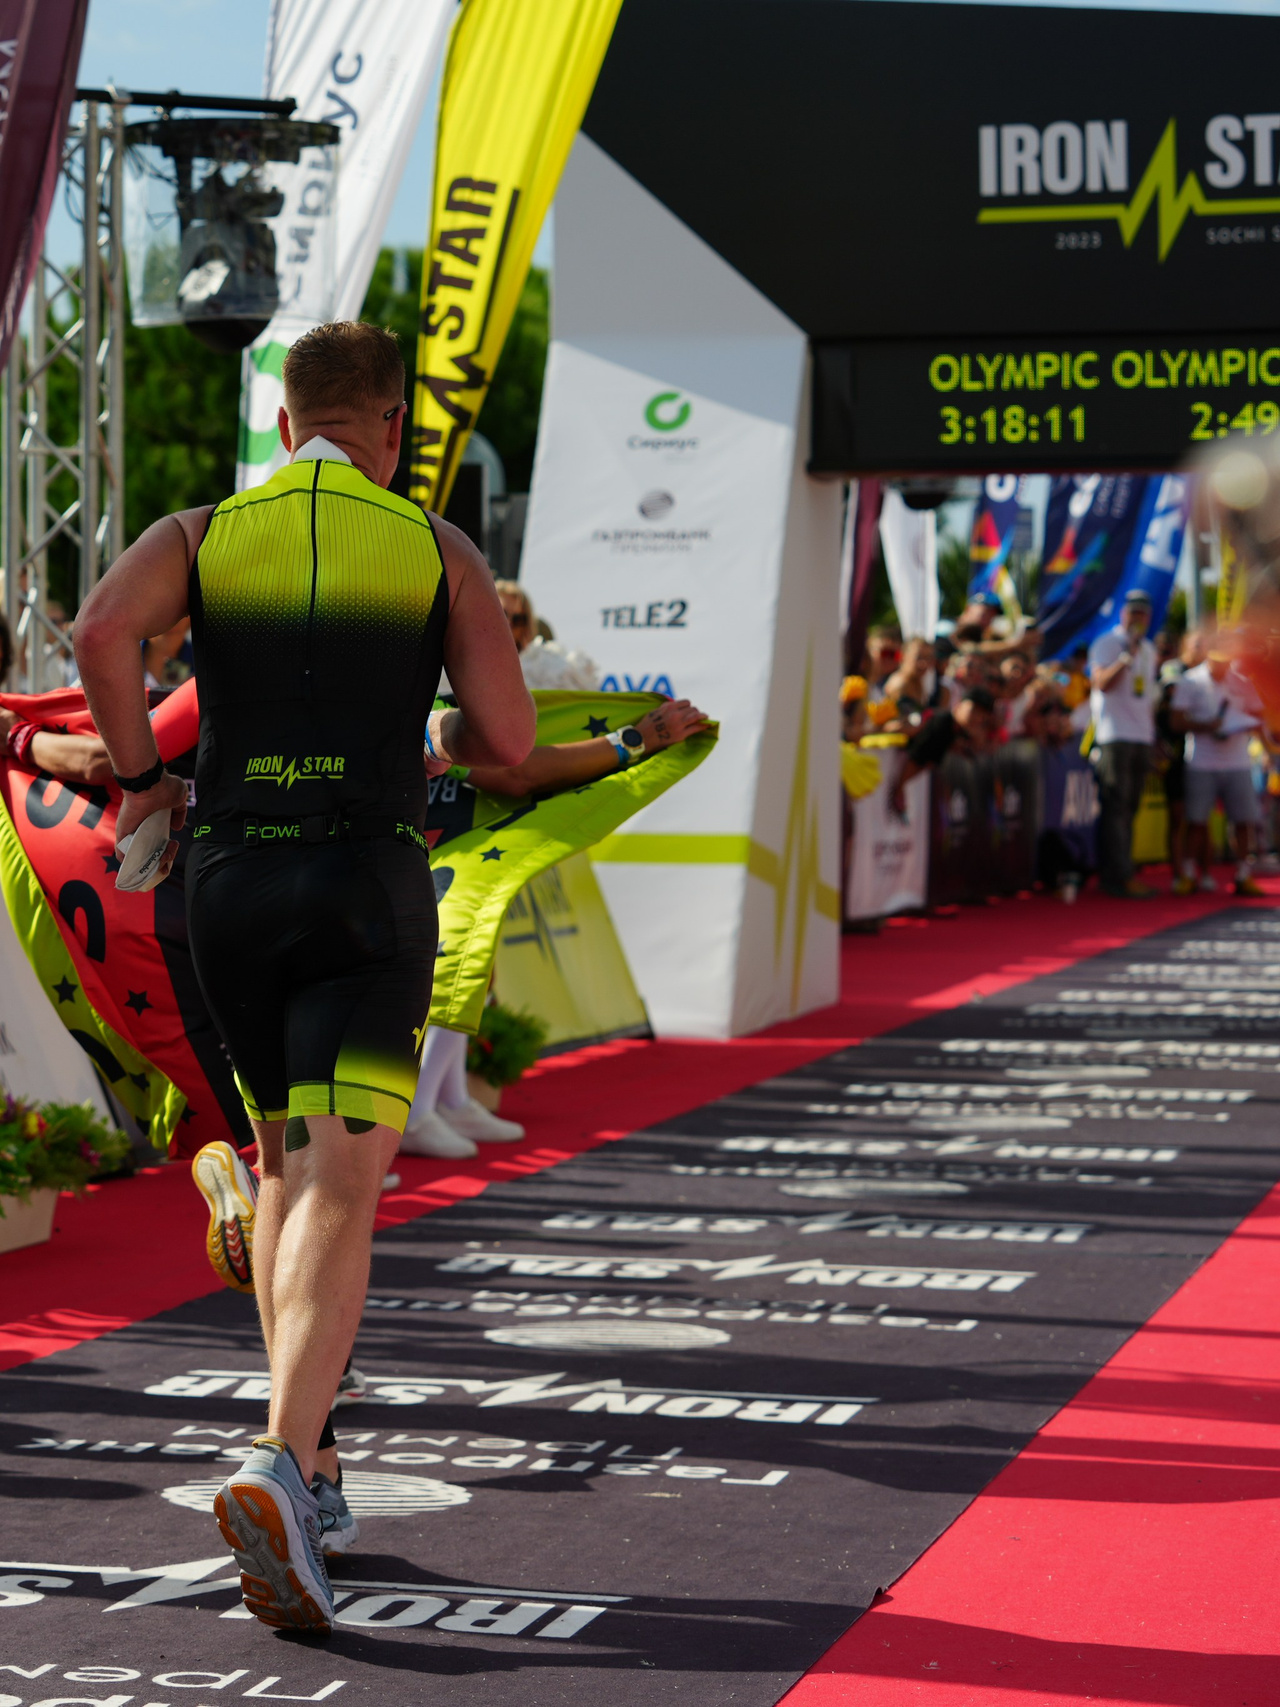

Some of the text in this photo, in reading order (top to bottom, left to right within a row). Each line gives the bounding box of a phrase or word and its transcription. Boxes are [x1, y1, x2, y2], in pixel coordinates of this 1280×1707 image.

[978, 112, 1280, 198] IRON ST
[1054, 231, 1103, 251] 2023
[928, 348, 1280, 393] OLYMPIC OLYMPIC
[938, 404, 1087, 445] 3:18:11
[600, 599, 690, 630] TELE2
[246, 755, 346, 774] IRON STAR
[138, 850, 162, 875] Columbia
[434, 1255, 1027, 1293] IRON STAR
[568, 1391, 865, 1426] IRON
